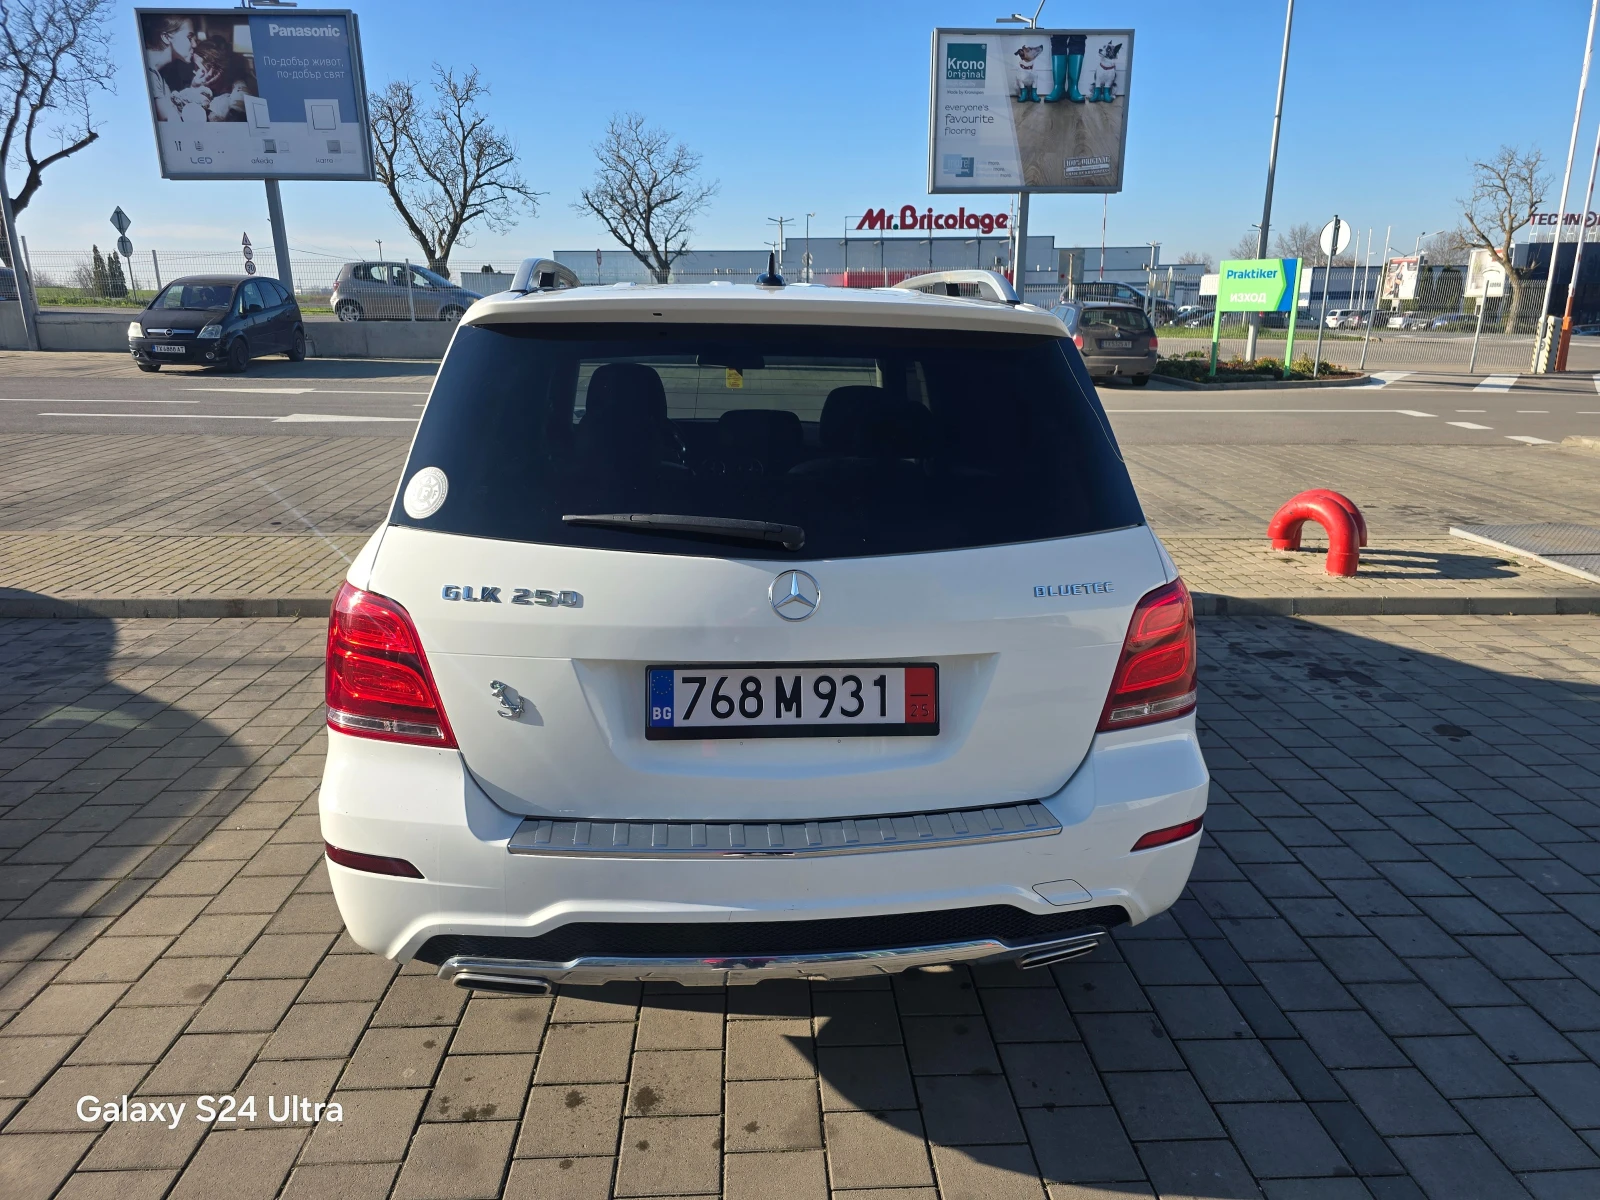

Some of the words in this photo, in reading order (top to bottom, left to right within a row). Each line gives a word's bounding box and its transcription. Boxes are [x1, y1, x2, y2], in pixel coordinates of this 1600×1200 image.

[268, 23, 341, 37] Panasonic
[263, 56, 310, 67] По-добър
[312, 58, 344, 67] живот,
[947, 57, 985, 70] Krono
[276, 69, 321, 80] по-добър
[323, 71, 345, 79] свят
[947, 70, 985, 80] Original
[945, 104, 989, 113] everyone's
[945, 113, 994, 126] favourite
[945, 127, 976, 136] flooring
[1226, 269, 1278, 279] Praktiker
[1229, 293, 1266, 304] ИЗХОД
[1033, 581, 1115, 597] BLUETEC
[442, 584, 502, 603] GLK
[510, 588, 583, 608] 250
[681, 676, 764, 720] 768
[775, 675, 802, 719] M
[813, 674, 887, 718] 931
[652, 706, 672, 720] BG
[910, 704, 930, 717] 25
